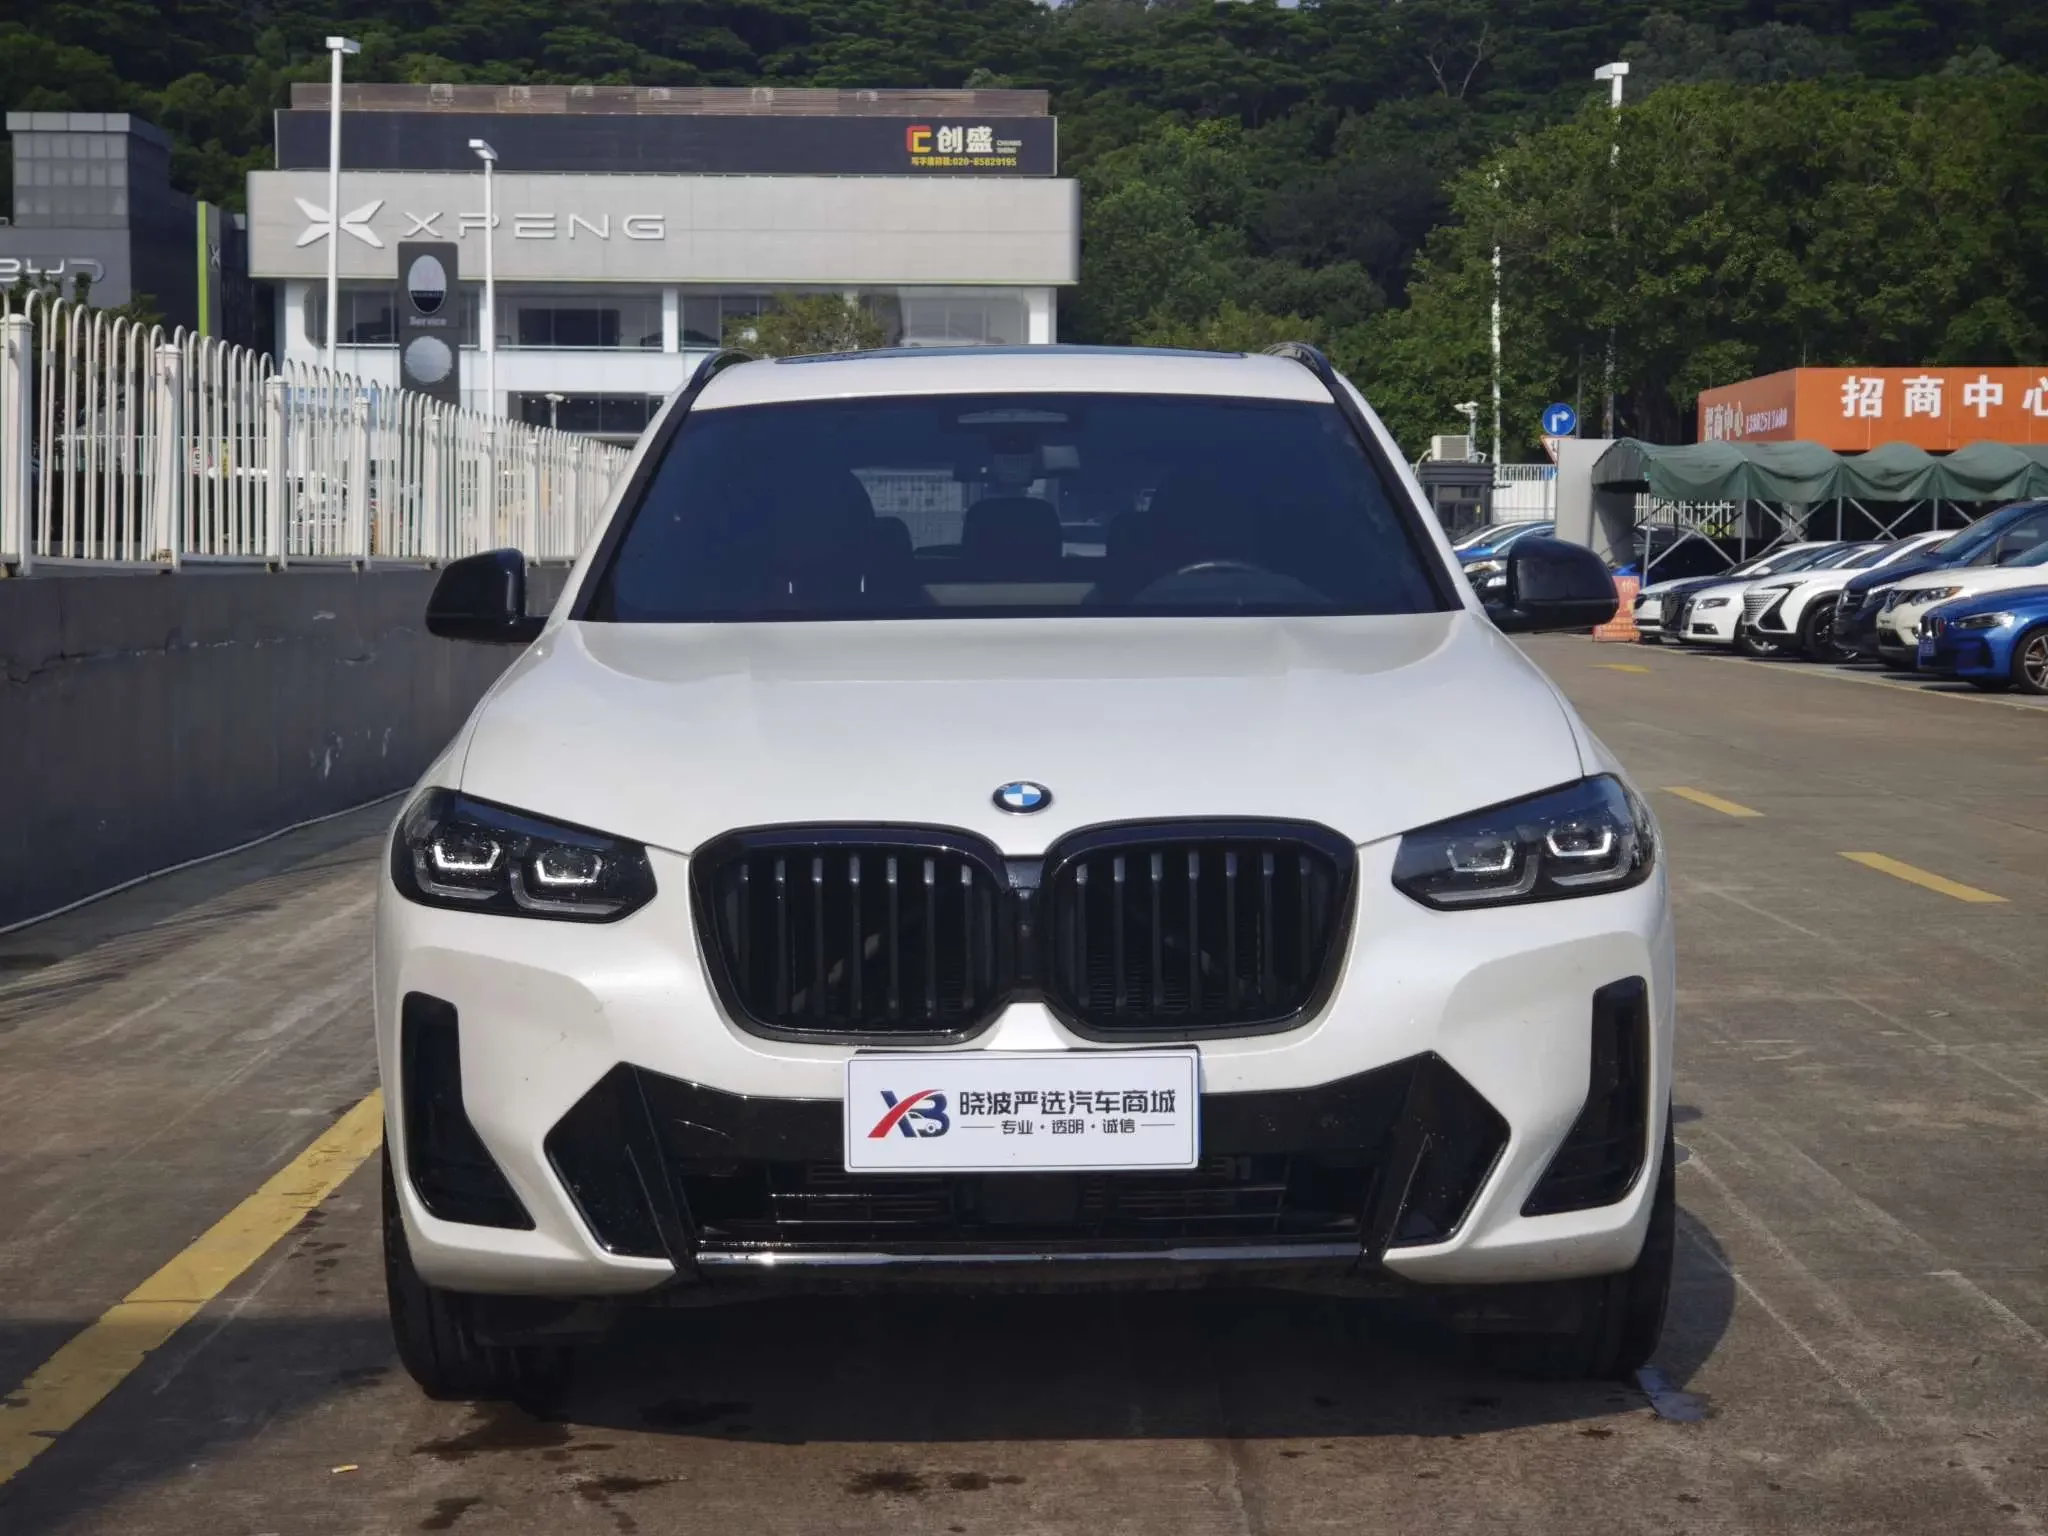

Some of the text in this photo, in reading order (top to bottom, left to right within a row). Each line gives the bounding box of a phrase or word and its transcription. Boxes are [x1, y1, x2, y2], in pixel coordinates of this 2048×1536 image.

[936, 125, 994, 154] 创盛
[403, 211, 665, 240] XPENG
[1840, 374, 2048, 419] 招商中心
[1704, 400, 1744, 441] 招商中心
[959, 1089, 1176, 1115] 晓波严选汽车商城
